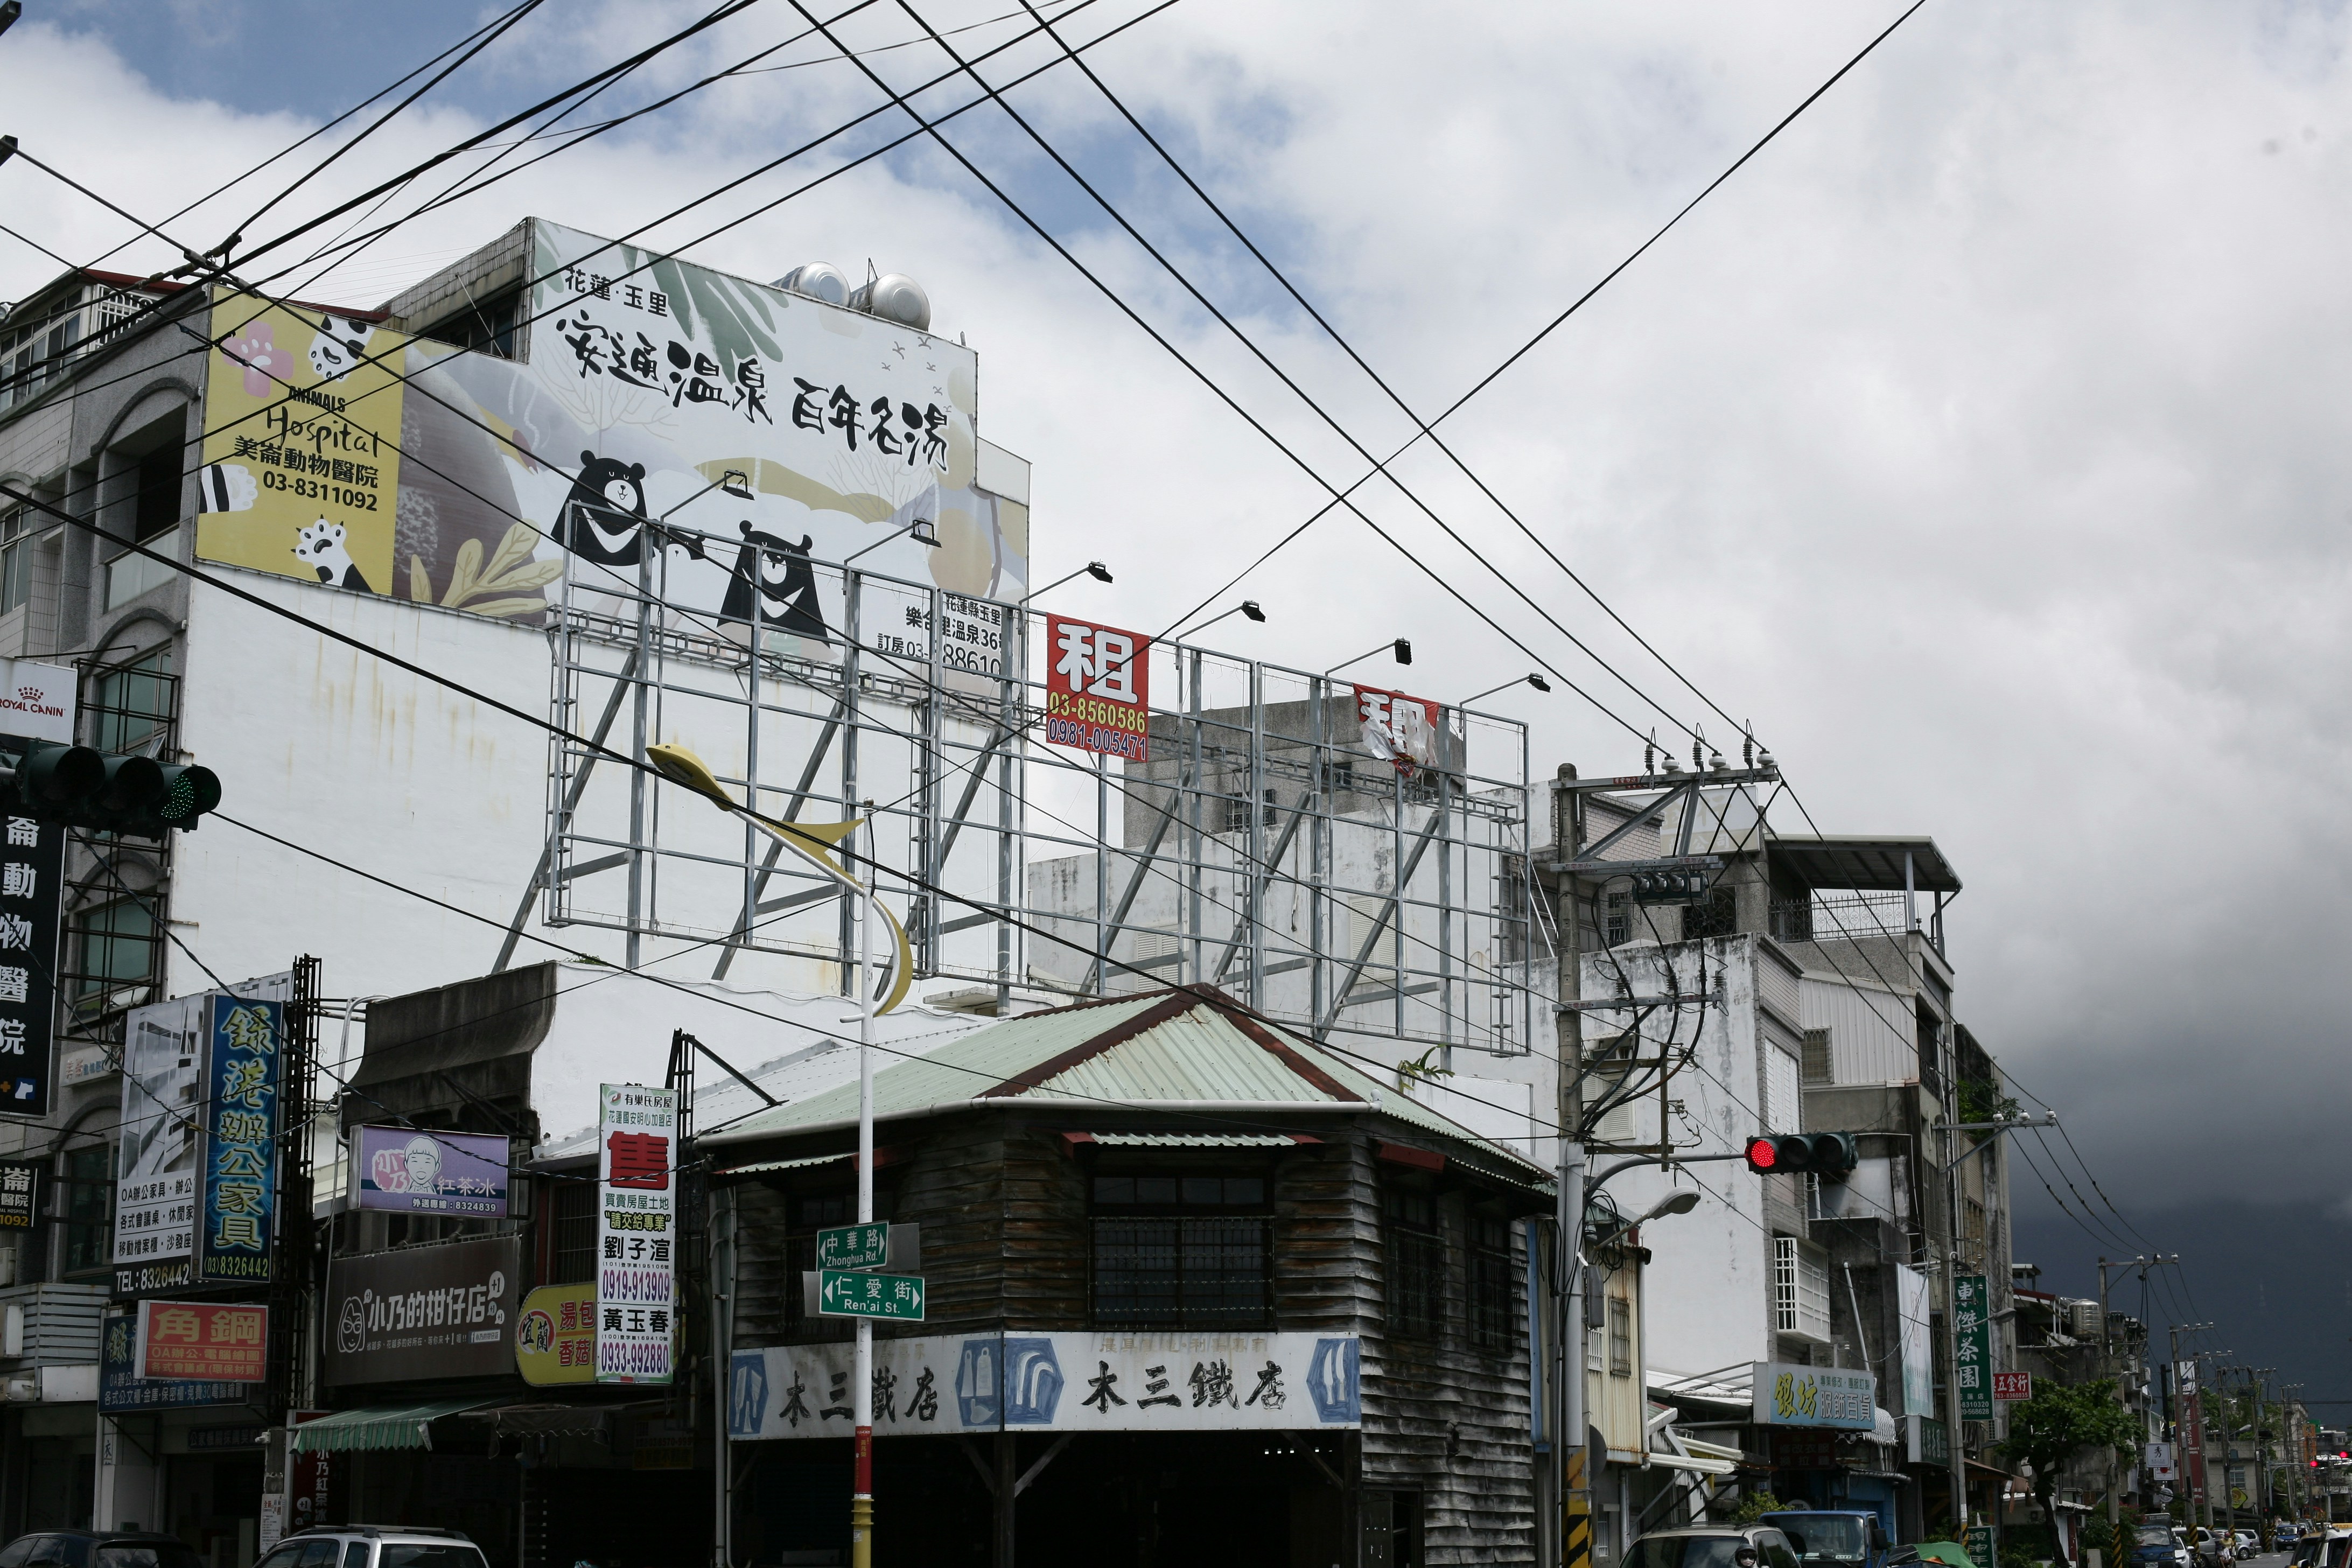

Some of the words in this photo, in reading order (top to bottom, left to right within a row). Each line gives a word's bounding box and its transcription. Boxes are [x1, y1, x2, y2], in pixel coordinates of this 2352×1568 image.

[289, 385, 346, 413] ANIMALS
[267, 405, 379, 458] Hospital
[234, 435, 379, 488] 美崙動物醫院
[263, 470, 377, 512] 03-8311092
[877, 633, 904, 655] 訂房
[1056, 623, 1138, 704] 租
[30, 704, 63, 717] CANIN
[1049, 691, 1146, 733] 03-8560586
[1048, 718, 1146, 761] 0981-005471
[625, 1094, 673, 1108] 有巢氏房屋
[608, 1110, 672, 1126] 花蓮國安明心加盟店
[607, 1131, 669, 1191] 售
[0, 1167, 31, 1192] 崙
[437, 1175, 496, 1198] 紅茶冰
[605, 1193, 669, 1210] 買賣房屋土地
[827, 1228, 878, 1254] 中華路
[827, 1255, 864, 1267] Zhonghua
[865, 1250, 878, 1262] Rd.
[603, 1269, 670, 1302] 0919-913909
[836, 1276, 911, 1300] 仁愛街
[367, 1284, 487, 1332] 小乃的柑仔店
[560, 1300, 595, 1329] 湯包
[844, 1298, 879, 1312] Ren'ai
[885, 1301, 900, 1313] St.
[153, 1307, 261, 1345] 角鋼
[522, 1313, 549, 1353] 宜蘭
[603, 1308, 669, 1333] 黃玉春
[559, 1339, 594, 1366] 香菇
[601, 1341, 669, 1374] 0933-992880
[1774, 1372, 1817, 1419] 銀坊
[1821, 1390, 1872, 1422] 服飾百貨
